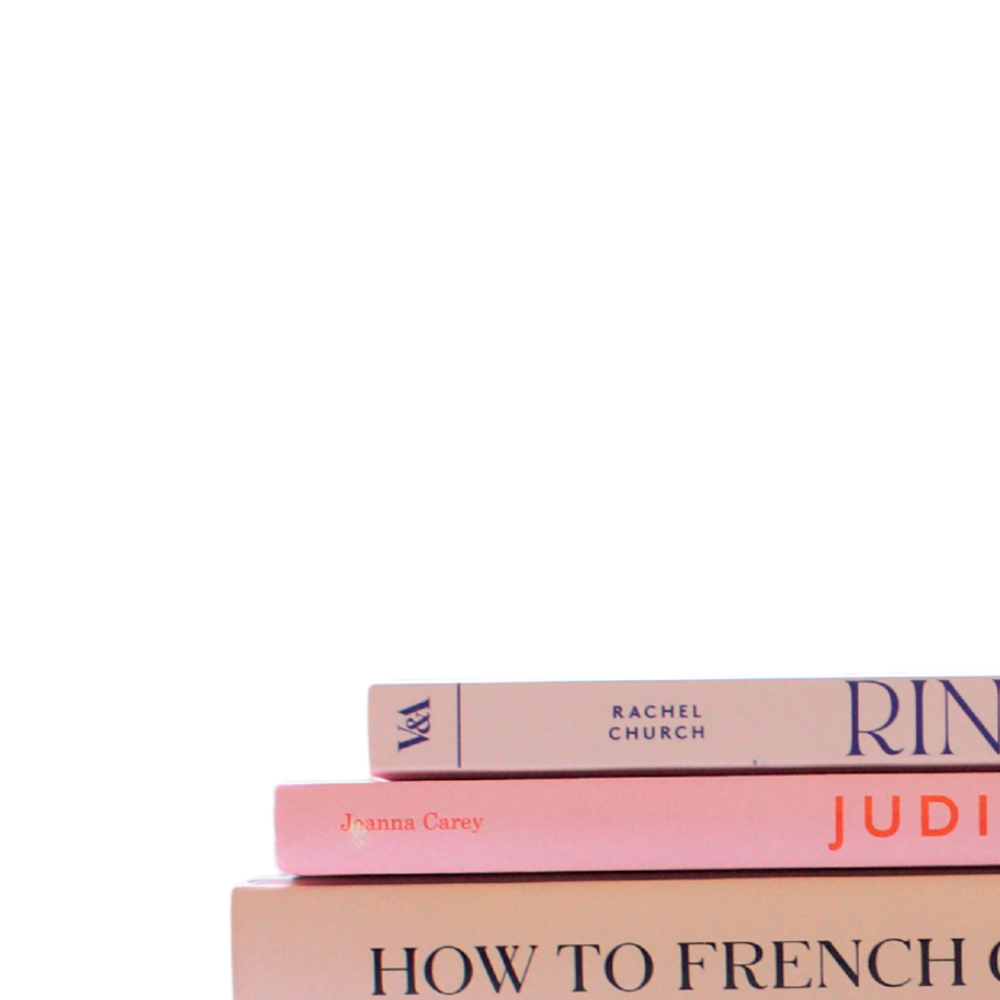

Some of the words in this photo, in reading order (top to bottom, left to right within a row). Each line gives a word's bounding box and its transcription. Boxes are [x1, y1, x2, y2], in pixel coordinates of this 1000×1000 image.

[613, 705, 700, 718] RACHEL
[397, 697, 430, 752] V&A
[609, 726, 704, 740] CHURCH
[423, 812, 484, 833] Carey
[372, 945, 537, 995] HOW
[558, 943, 653, 992] TO
[679, 938, 965, 990] FRENCH
